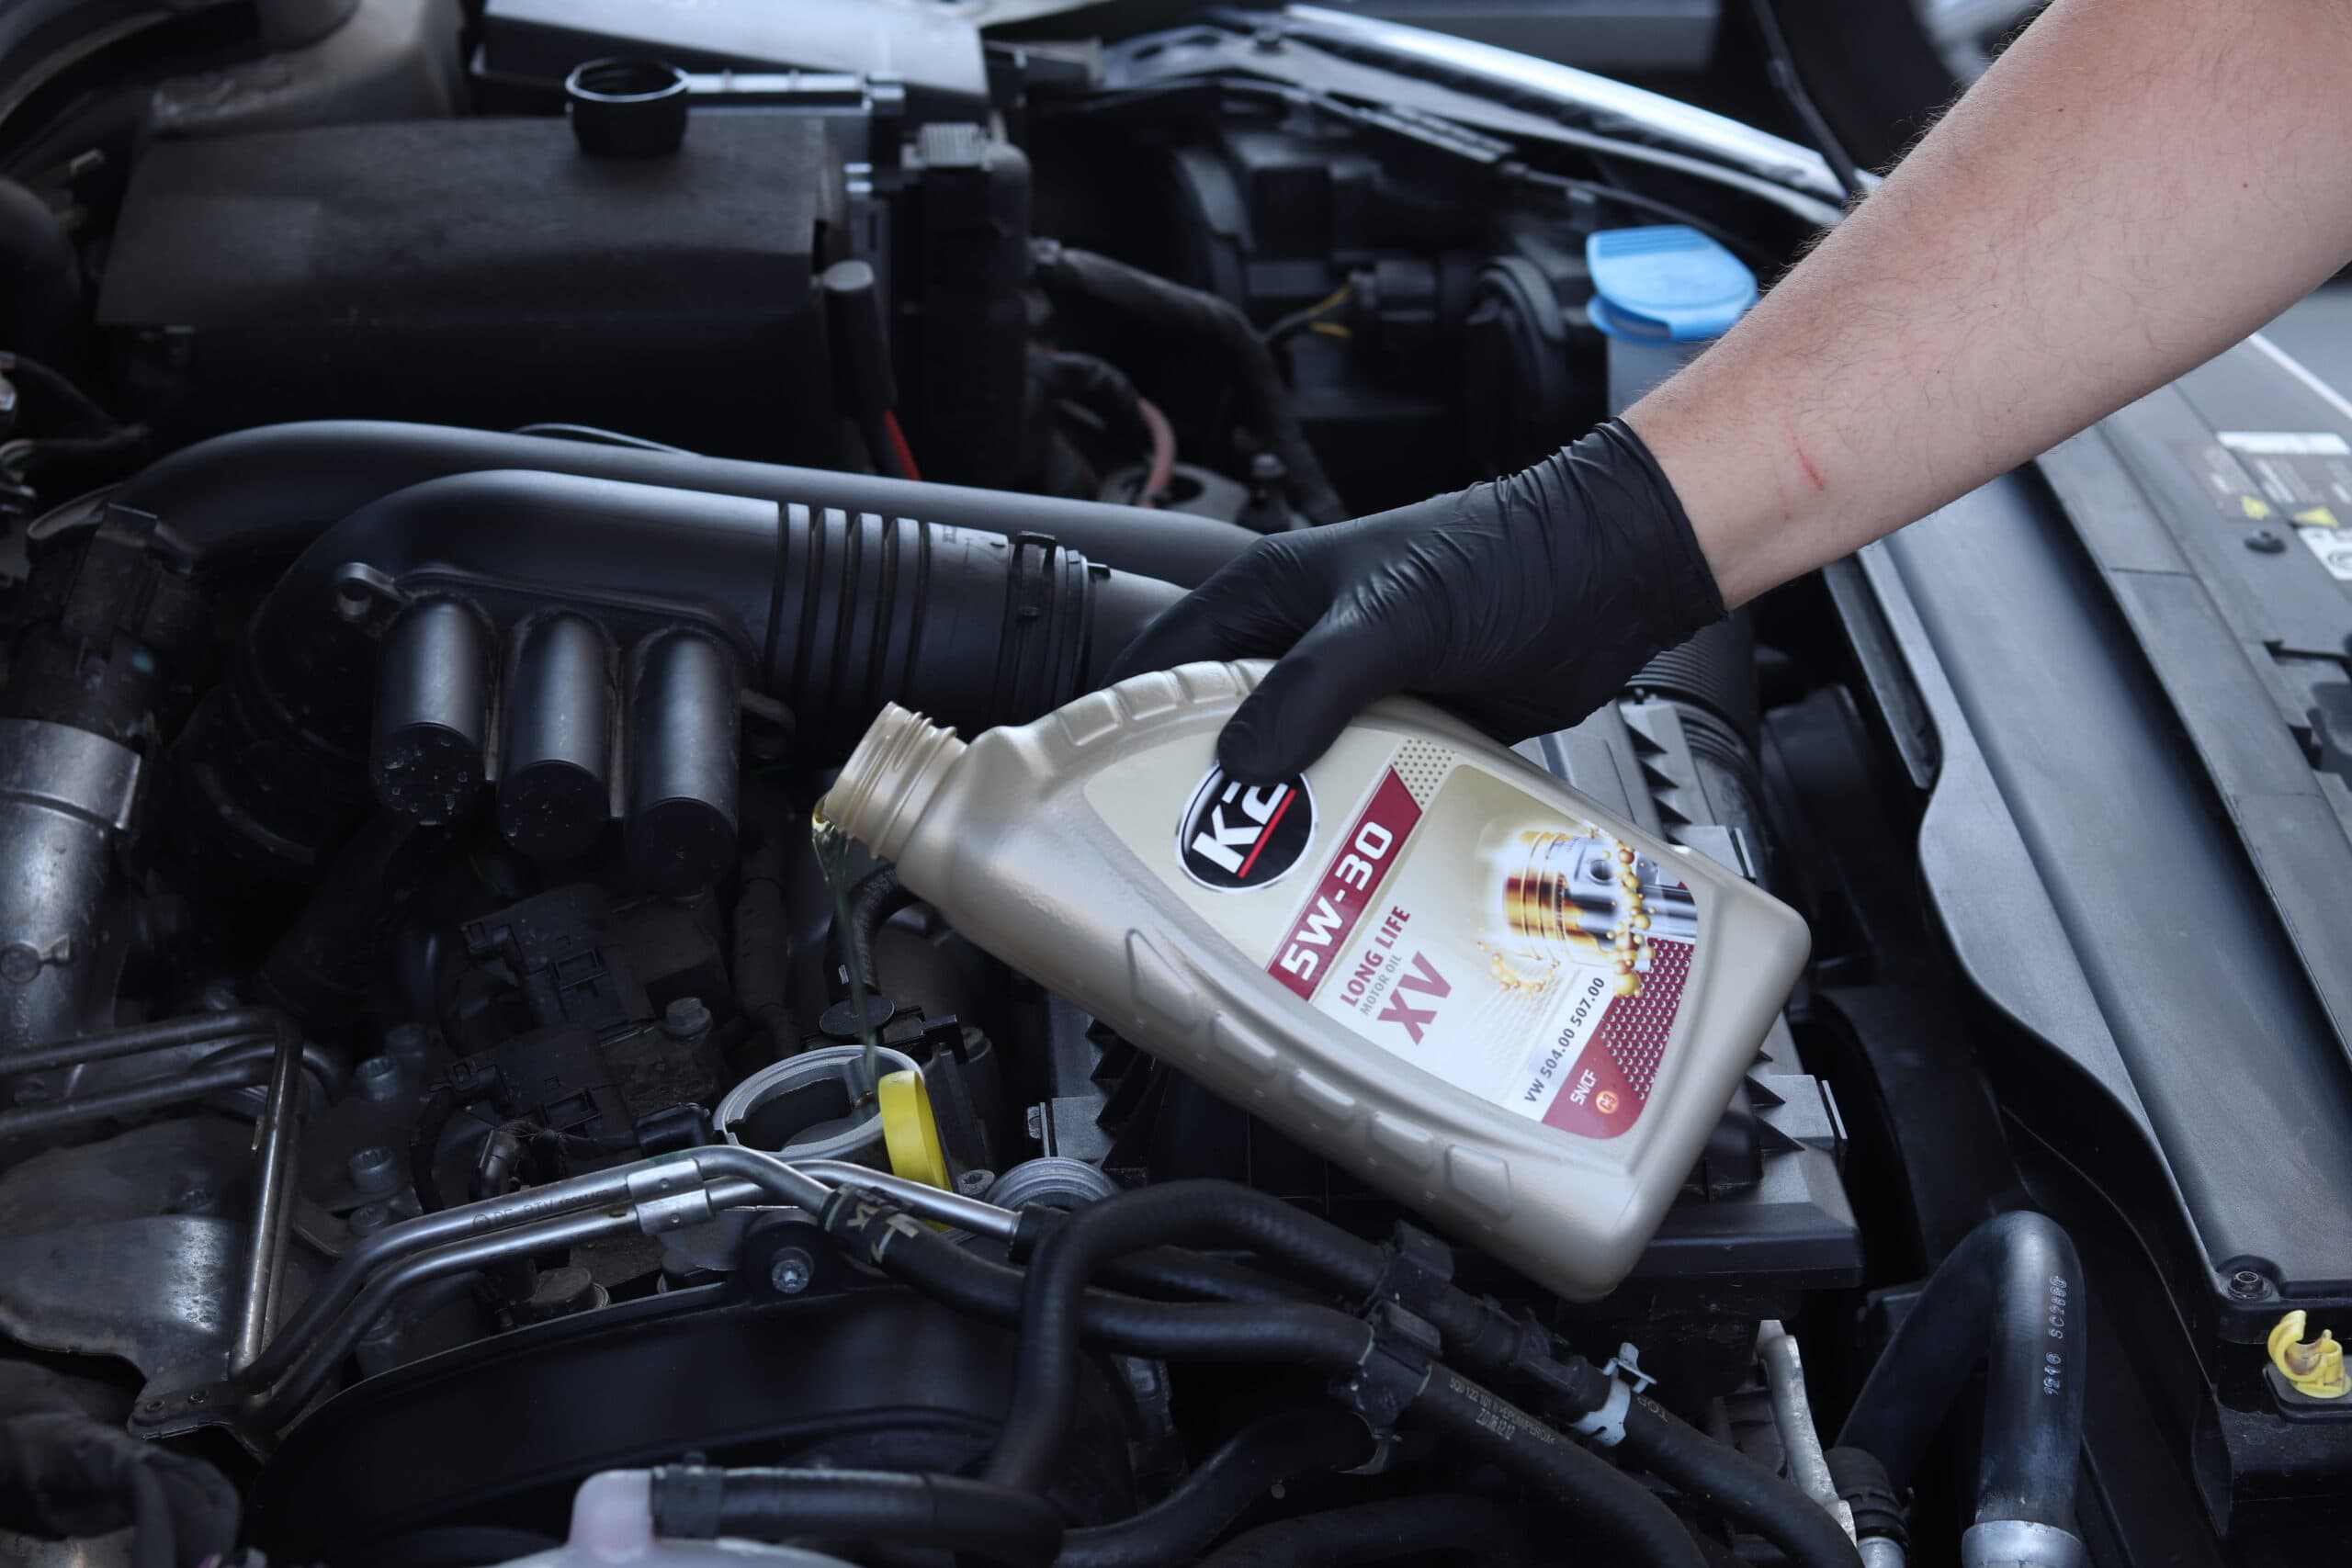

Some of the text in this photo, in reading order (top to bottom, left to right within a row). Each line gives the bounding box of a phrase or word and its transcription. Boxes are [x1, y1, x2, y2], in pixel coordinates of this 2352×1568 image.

[1192, 782, 1289, 874] K2
[1280, 821, 1394, 981] 5W-30
[1340, 906, 1411, 1007] LONG LIFE
[1359, 953, 1403, 1016] MOTOR OIL
[1376, 951, 1453, 1046] XV
[1523, 976, 1605, 1103] VW 504.00 507.00
